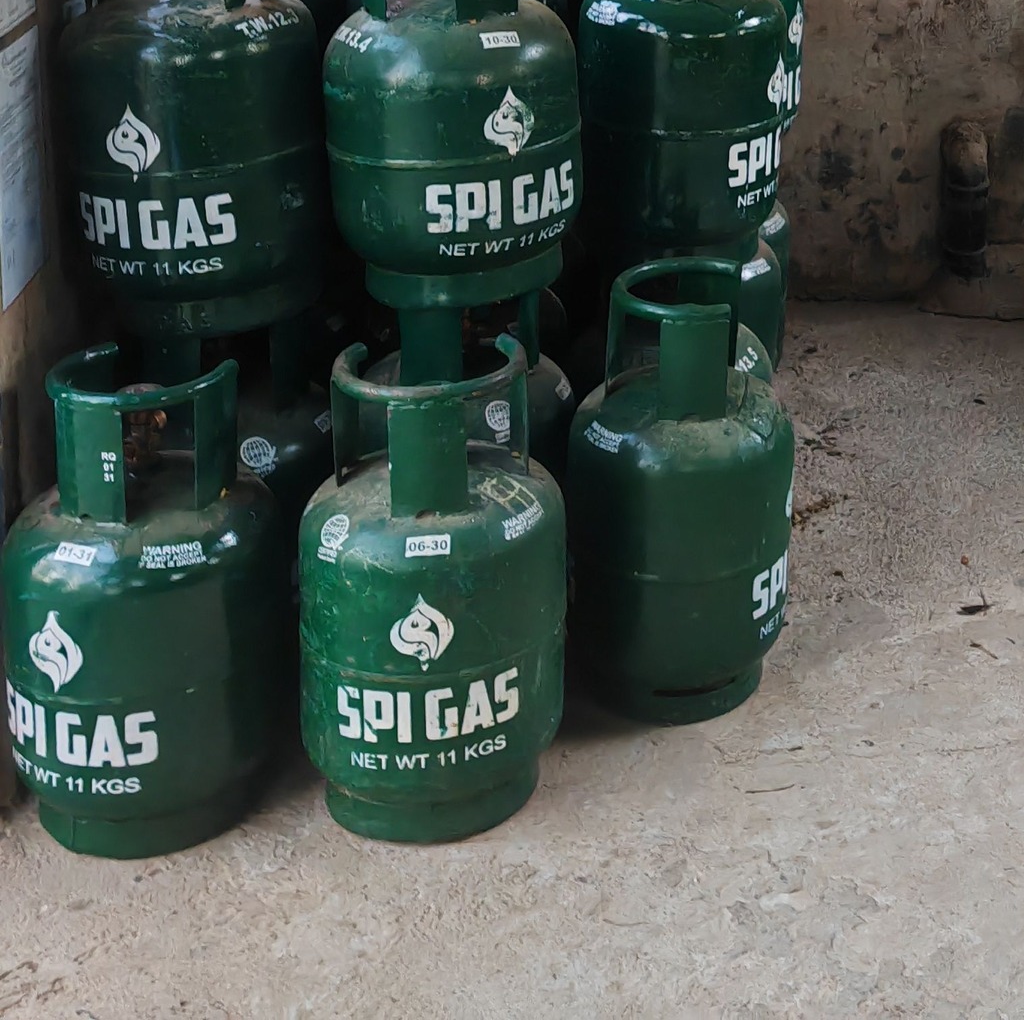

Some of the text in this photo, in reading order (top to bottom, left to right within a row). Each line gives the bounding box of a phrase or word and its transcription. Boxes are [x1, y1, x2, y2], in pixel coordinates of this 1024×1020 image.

[484, 34, 519, 46] 10-30
[728, 132, 772, 188] SPI
[425, 160, 575, 234] SPI GAS
[737, 182, 776, 208] NET WT
[79, 190, 238, 250] SPI GAS
[438, 219, 566, 257] NET WT 11 KGS
[91, 254, 224, 276] NET WT 11 KGS
[101, 452, 116, 462] RQ
[103, 462, 114, 472] 01
[104, 472, 114, 482] 31
[58, 546, 96, 561] 01-31
[142, 540, 202, 556] WARNING
[408, 540, 448, 552] 06-30
[760, 614, 782, 640] NET
[337, 666, 520, 744] SPI GAS
[6, 677, 160, 768] SPI GAS
[351, 734, 508, 770] NET WT 11 KGS
[12, 745, 142, 795] NET WT 11 KGS
